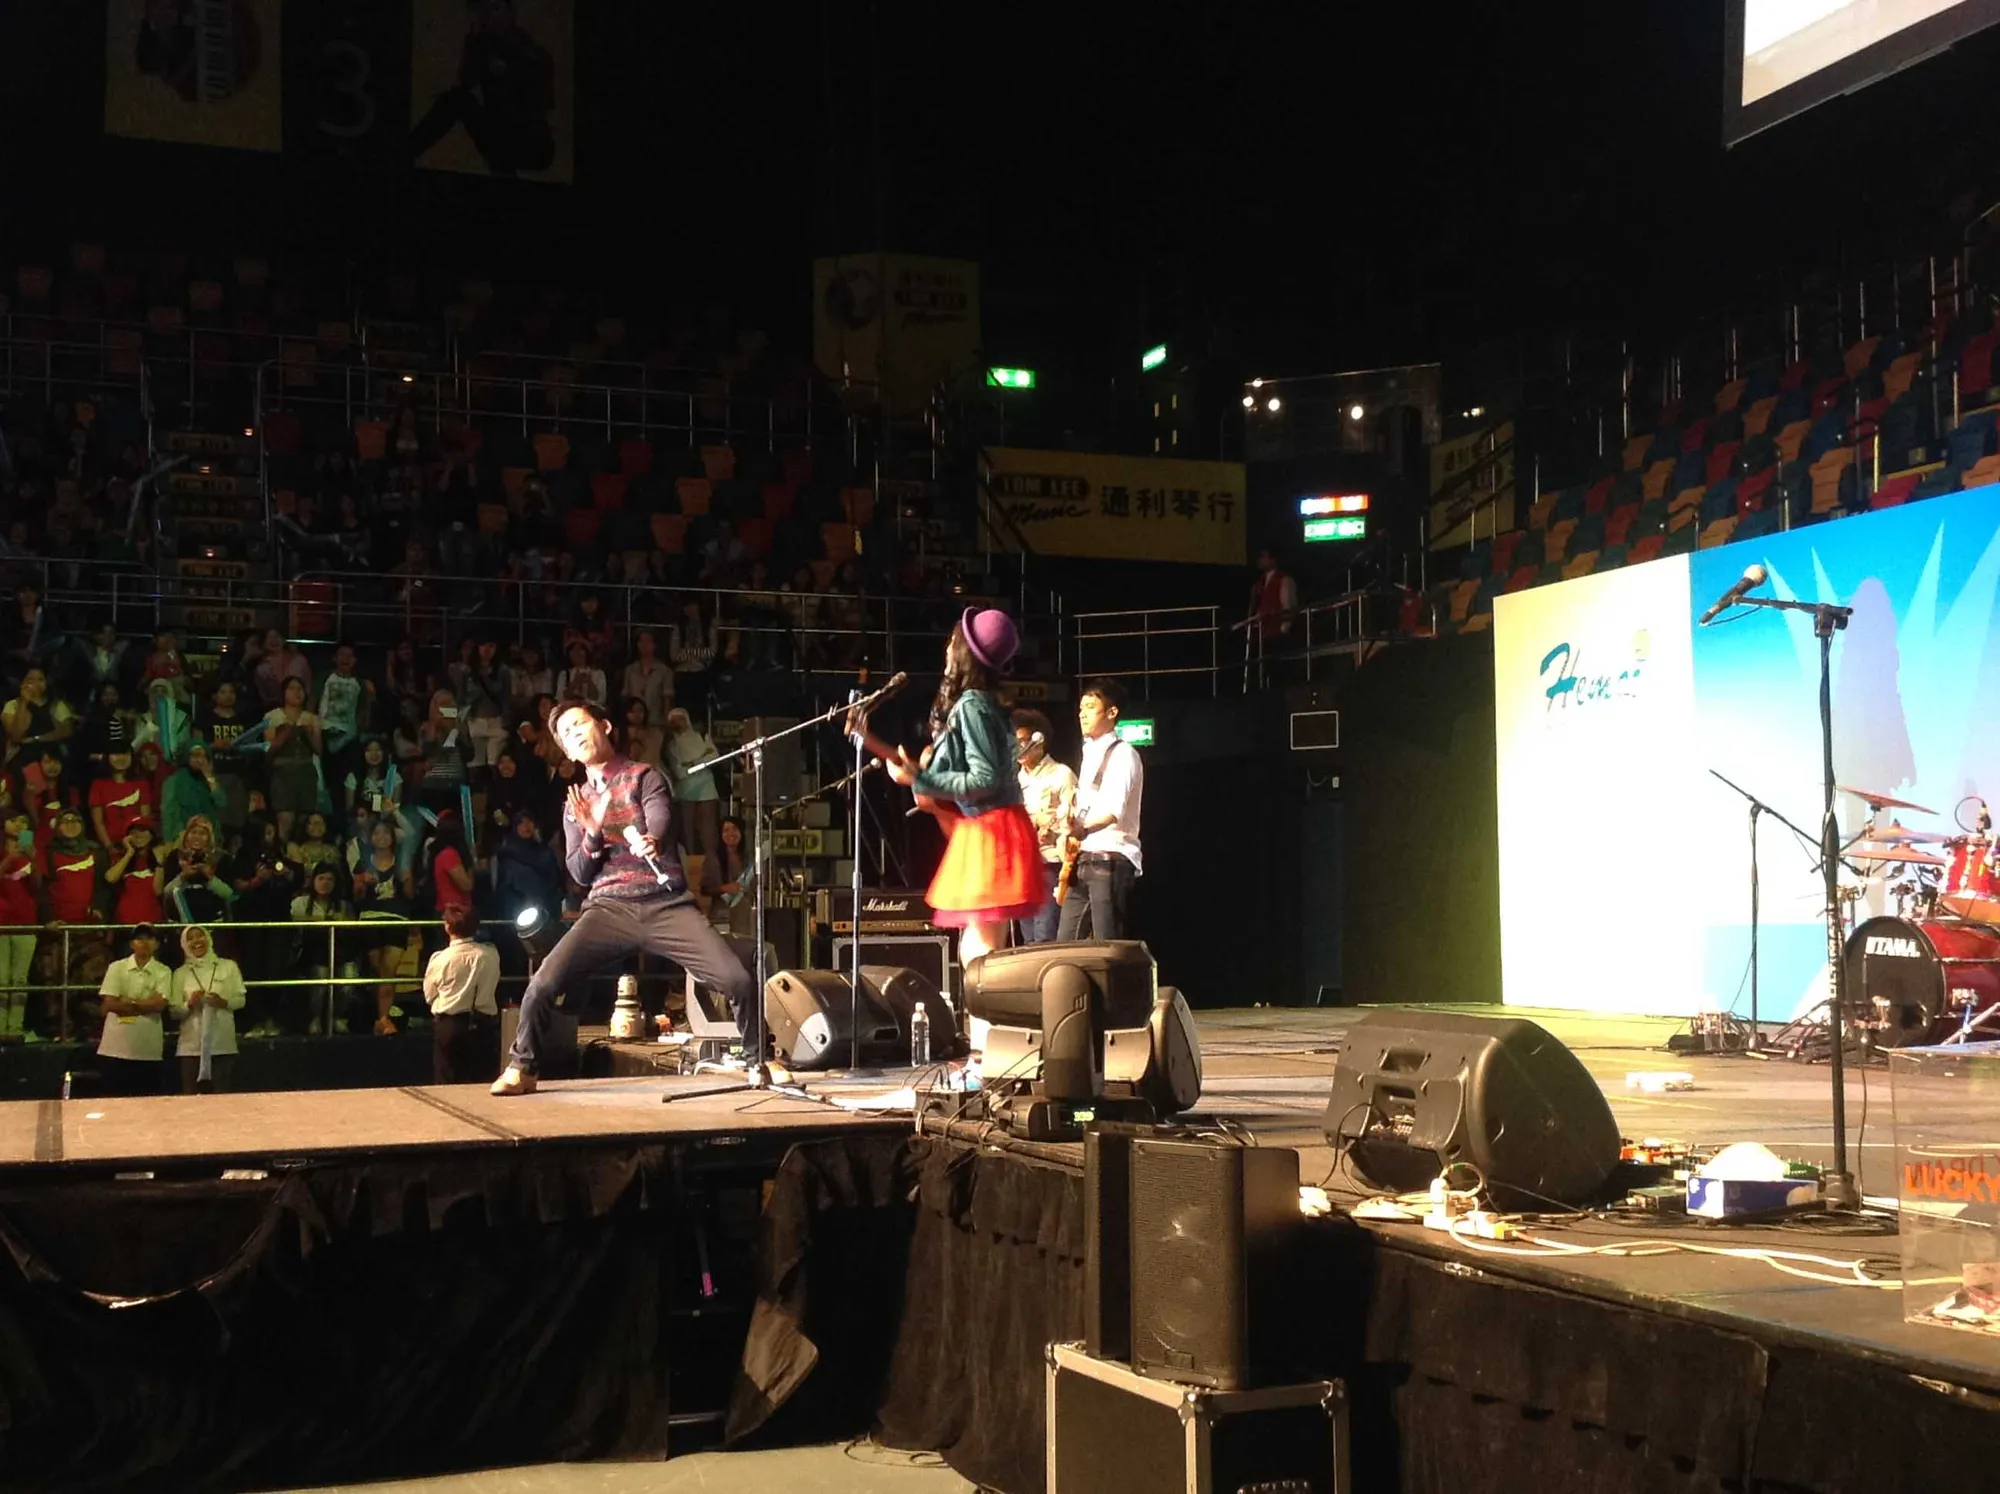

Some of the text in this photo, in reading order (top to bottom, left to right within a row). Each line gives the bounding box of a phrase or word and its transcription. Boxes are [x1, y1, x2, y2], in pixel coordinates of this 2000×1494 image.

[317, 39, 377, 138] 3
[1001, 476, 1083, 498] TOM LEE
[1101, 486, 1235, 524] 通利琴行
[862, 897, 908, 911] Marshall
[1904, 1164, 2000, 1203] LUCKY
